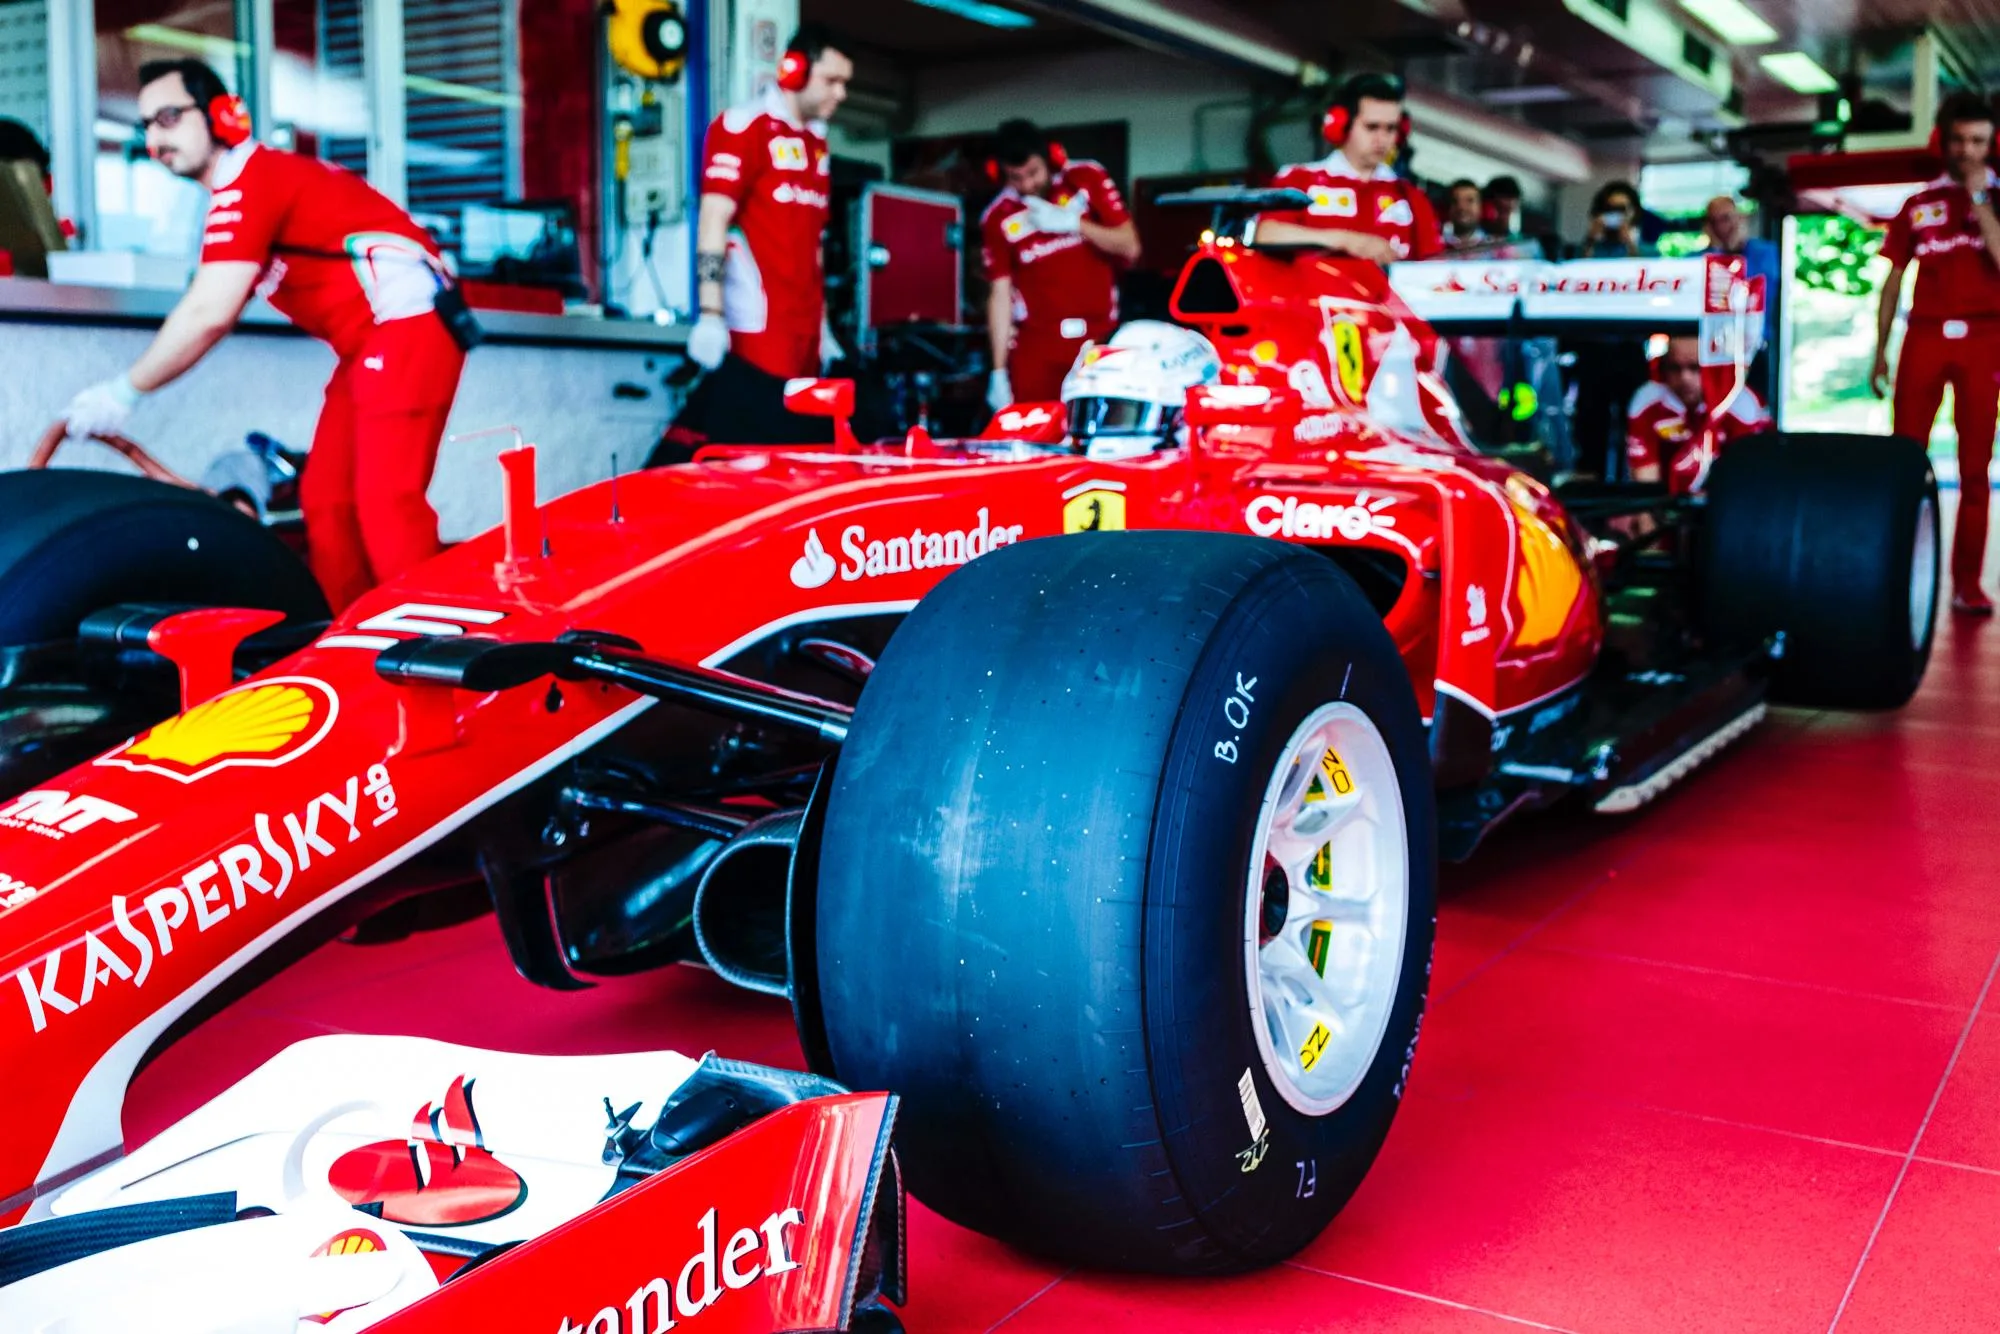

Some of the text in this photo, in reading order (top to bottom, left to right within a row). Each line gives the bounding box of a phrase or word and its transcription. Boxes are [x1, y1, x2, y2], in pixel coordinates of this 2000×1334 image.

[841, 507, 1024, 582] Santander
[16, 763, 398, 1033] KASPERSKY lab
